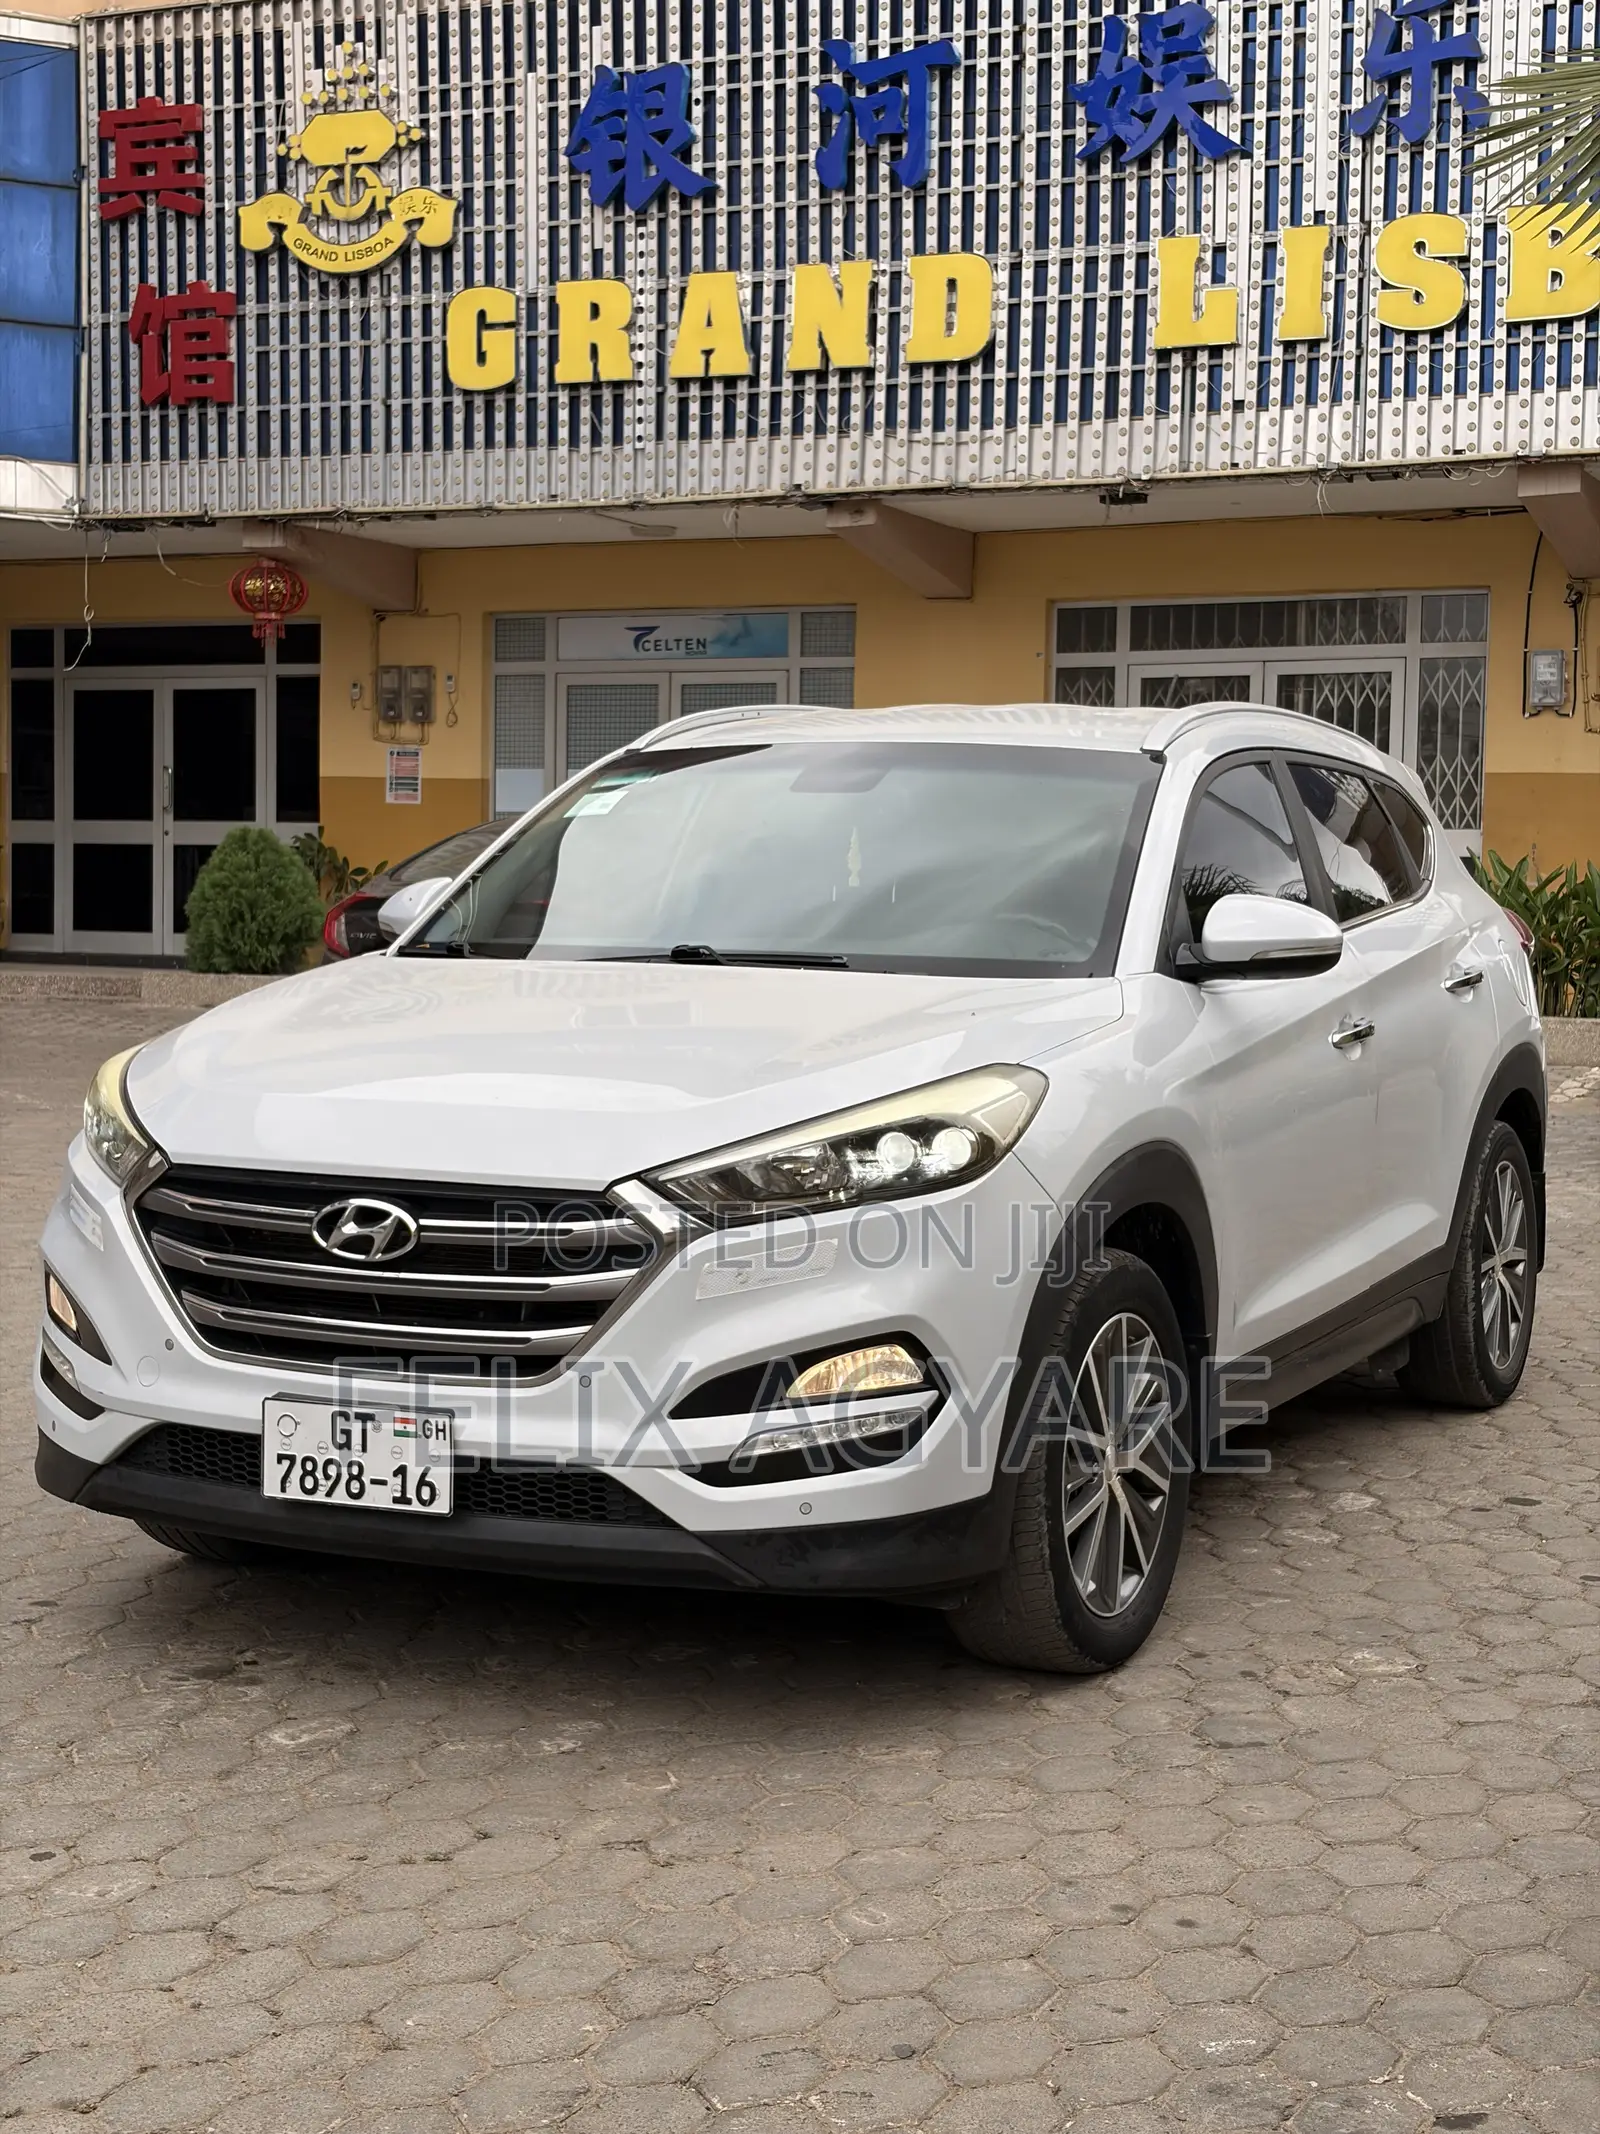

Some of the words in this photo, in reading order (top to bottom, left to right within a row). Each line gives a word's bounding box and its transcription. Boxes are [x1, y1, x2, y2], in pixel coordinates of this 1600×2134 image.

[564, 0, 1491, 211] 银河娱乐
[99, 96, 238, 407] 宾馆
[292, 237, 339, 262] GRAND
[344, 236, 395, 263] LISBOA
[446, 251, 995, 391] GRAND
[1154, 202, 1600, 349] LISB
[276, 1452, 437, 1507] 7898-16
[331, 1410, 376, 1454] GT
[421, 1418, 447, 1441] GH
